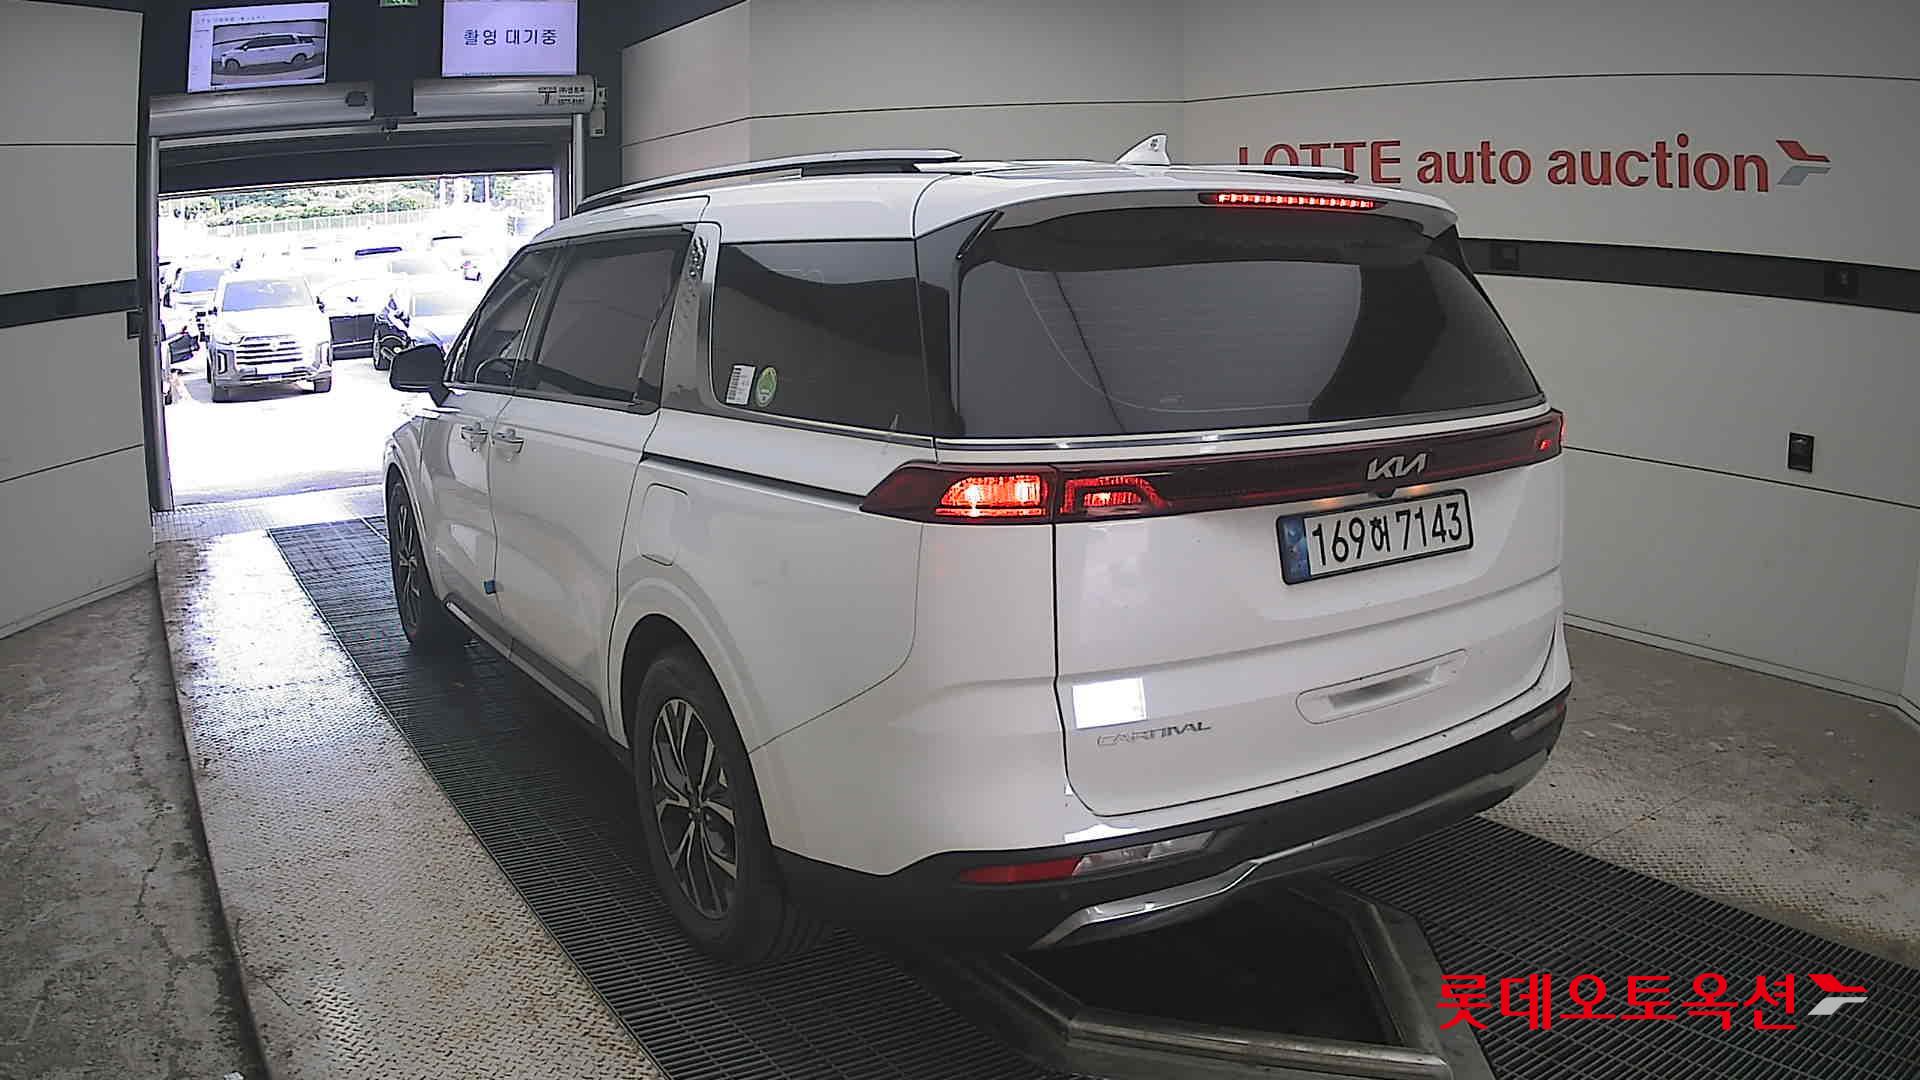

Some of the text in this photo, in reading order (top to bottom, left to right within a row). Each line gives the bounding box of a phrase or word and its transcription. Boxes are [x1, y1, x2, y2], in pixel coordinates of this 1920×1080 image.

[463, 28, 558, 46] 촬영 대기중
[1417, 142, 1532, 184] auto
[1548, 134, 1769, 192] auction
[1366, 452, 1427, 481] KIA
